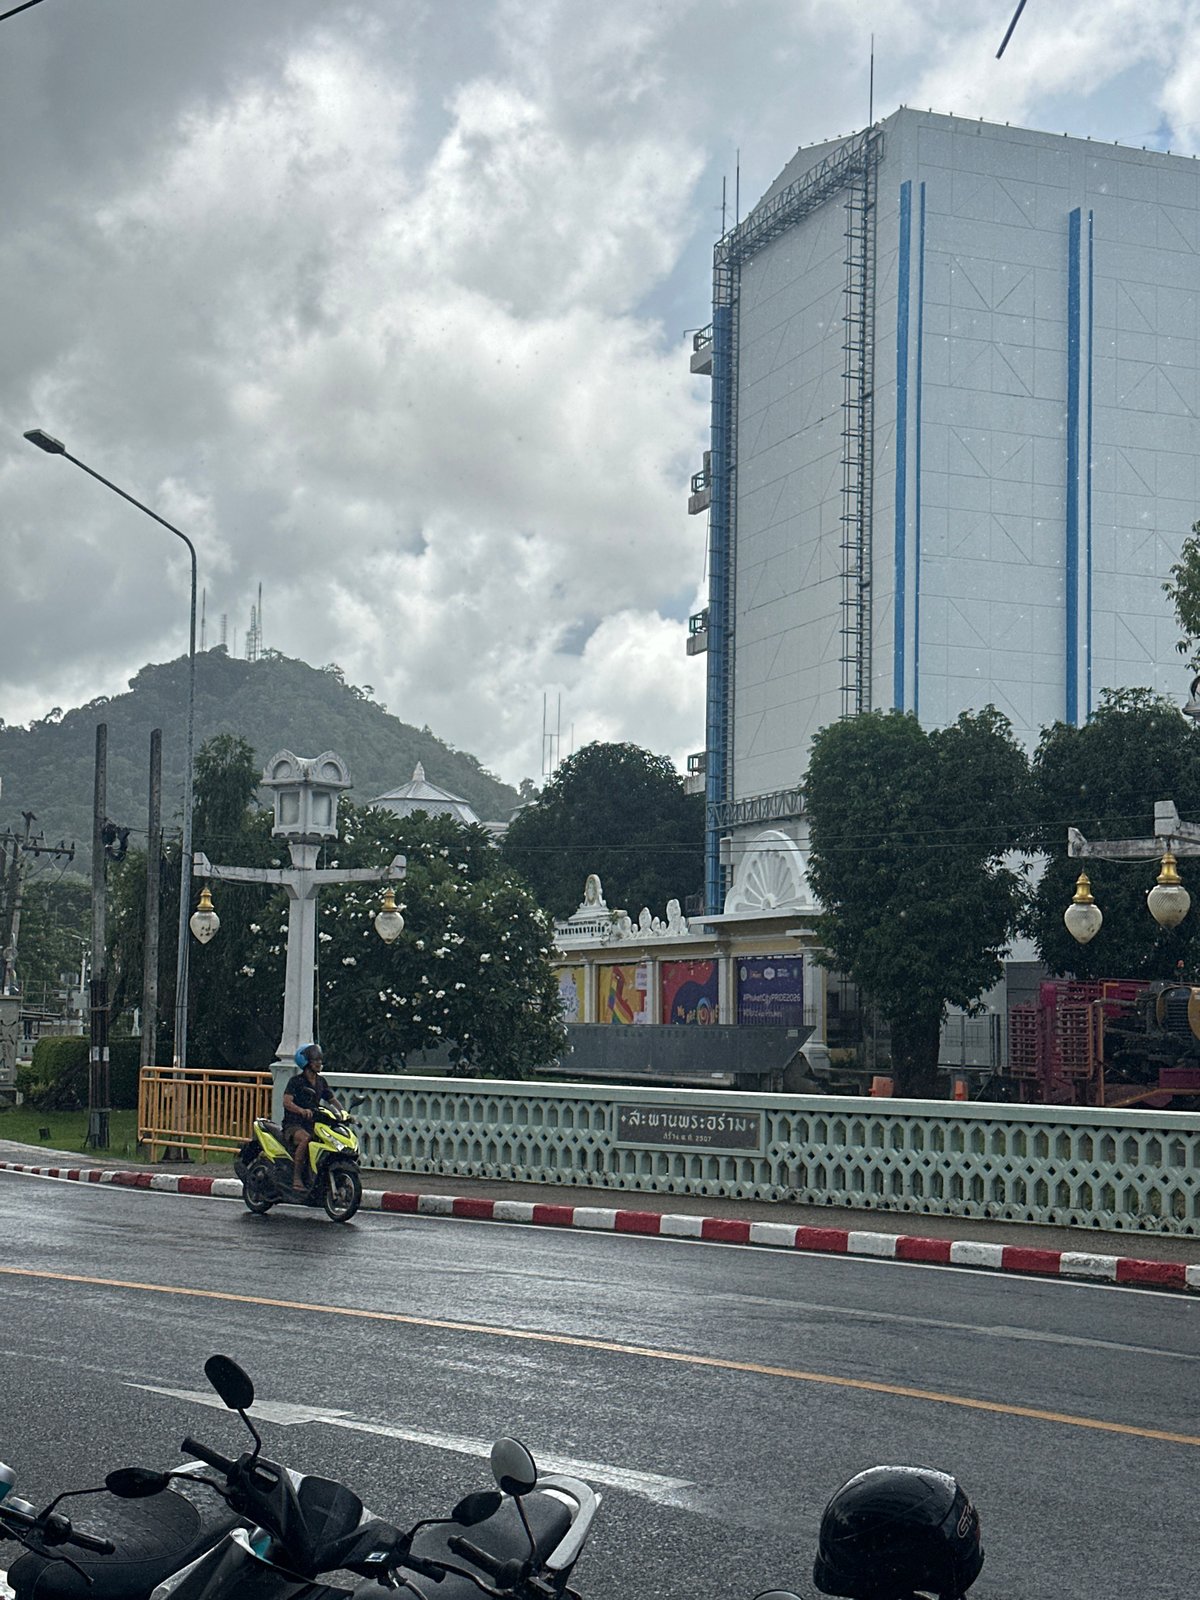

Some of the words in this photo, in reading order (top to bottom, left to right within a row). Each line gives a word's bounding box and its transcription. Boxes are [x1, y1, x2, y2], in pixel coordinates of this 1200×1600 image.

[629, 1110, 746, 1132] สะพานพระอร่าม
